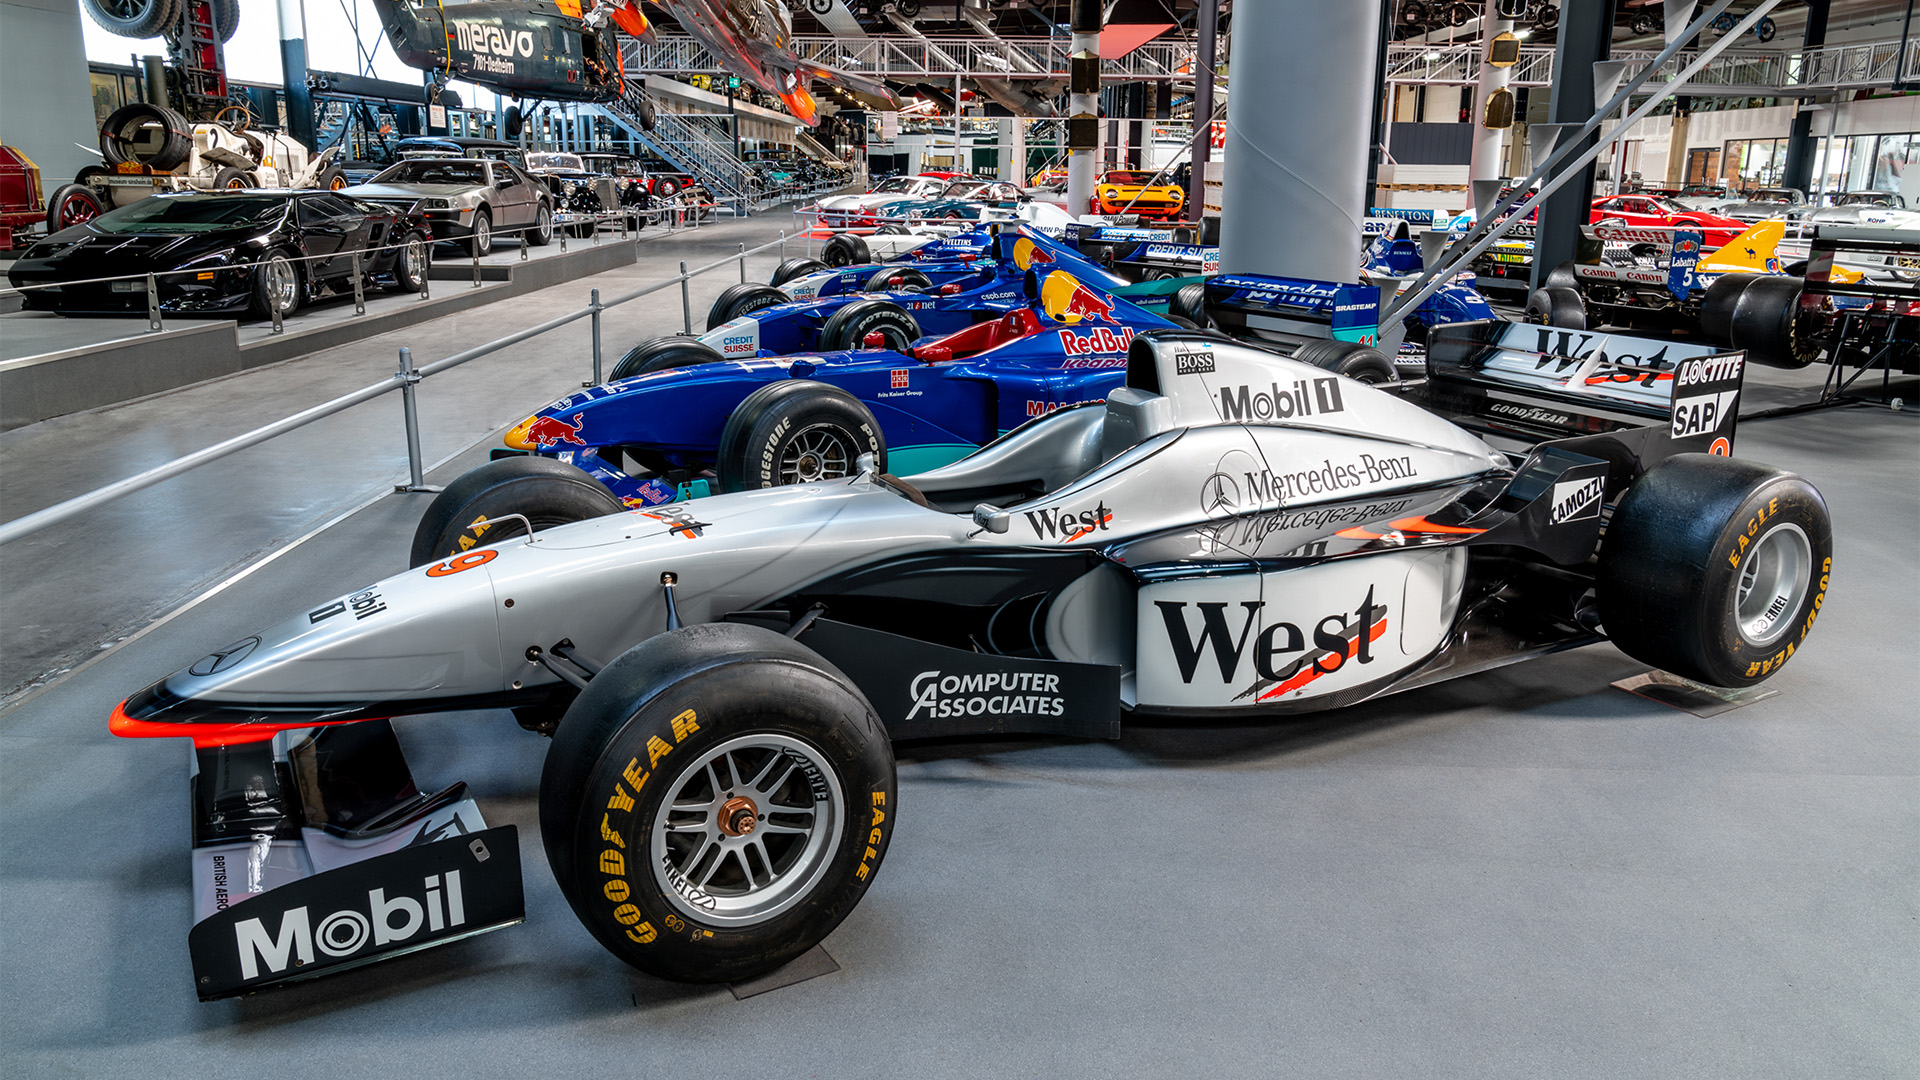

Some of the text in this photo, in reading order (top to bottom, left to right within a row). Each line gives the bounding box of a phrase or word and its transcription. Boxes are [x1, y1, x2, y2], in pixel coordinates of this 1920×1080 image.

[453, 19, 534, 58] meravo
[472, 54, 515, 75] 7101-Oedheim
[1375, 210, 1431, 221] BENETTON
[1150, 233, 1171, 242] CREDIT
[1594, 228, 1671, 244] Canon
[1146, 244, 1184, 256] CREDIT
[1672, 256, 1696, 268] Labatt's
[1582, 268, 1617, 279] Canon
[1626, 271, 1663, 283] Canon
[1682, 267, 1694, 287] 5
[794, 288, 815, 296] CREDIT
[981, 291, 1017, 301] cspb.com
[1335, 302, 1377, 312] BRASTEMP
[858, 311, 914, 331] POTENZA
[723, 336, 754, 345] CREDIT
[723, 343, 754, 354] SUISSE
[1178, 353, 1214, 369] BOSS
[1535, 328, 1676, 388] West
[1677, 353, 1745, 387] LOCTITE
[906, 389, 923, 397] Group
[1220, 378, 1340, 422] Mobil 1
[1674, 401, 1716, 436] SAP
[1244, 453, 1419, 505] Mercedes-Benz
[637, 482, 669, 504] RedBull
[1024, 500, 1110, 541] West
[1728, 497, 1779, 570] EAGLE
[426, 549, 499, 578] 9
[1764, 595, 1789, 623] ENKEI
[1154, 584, 1383, 684] West
[910, 671, 1060, 701] COMPUTER
[905, 685, 1065, 720] ASSOCIATES
[856, 791, 886, 883] EAGLE
[213, 855, 227, 887] BRITISH
[661, 853, 690, 897] ENKEI
[234, 869, 466, 981] Mobil
